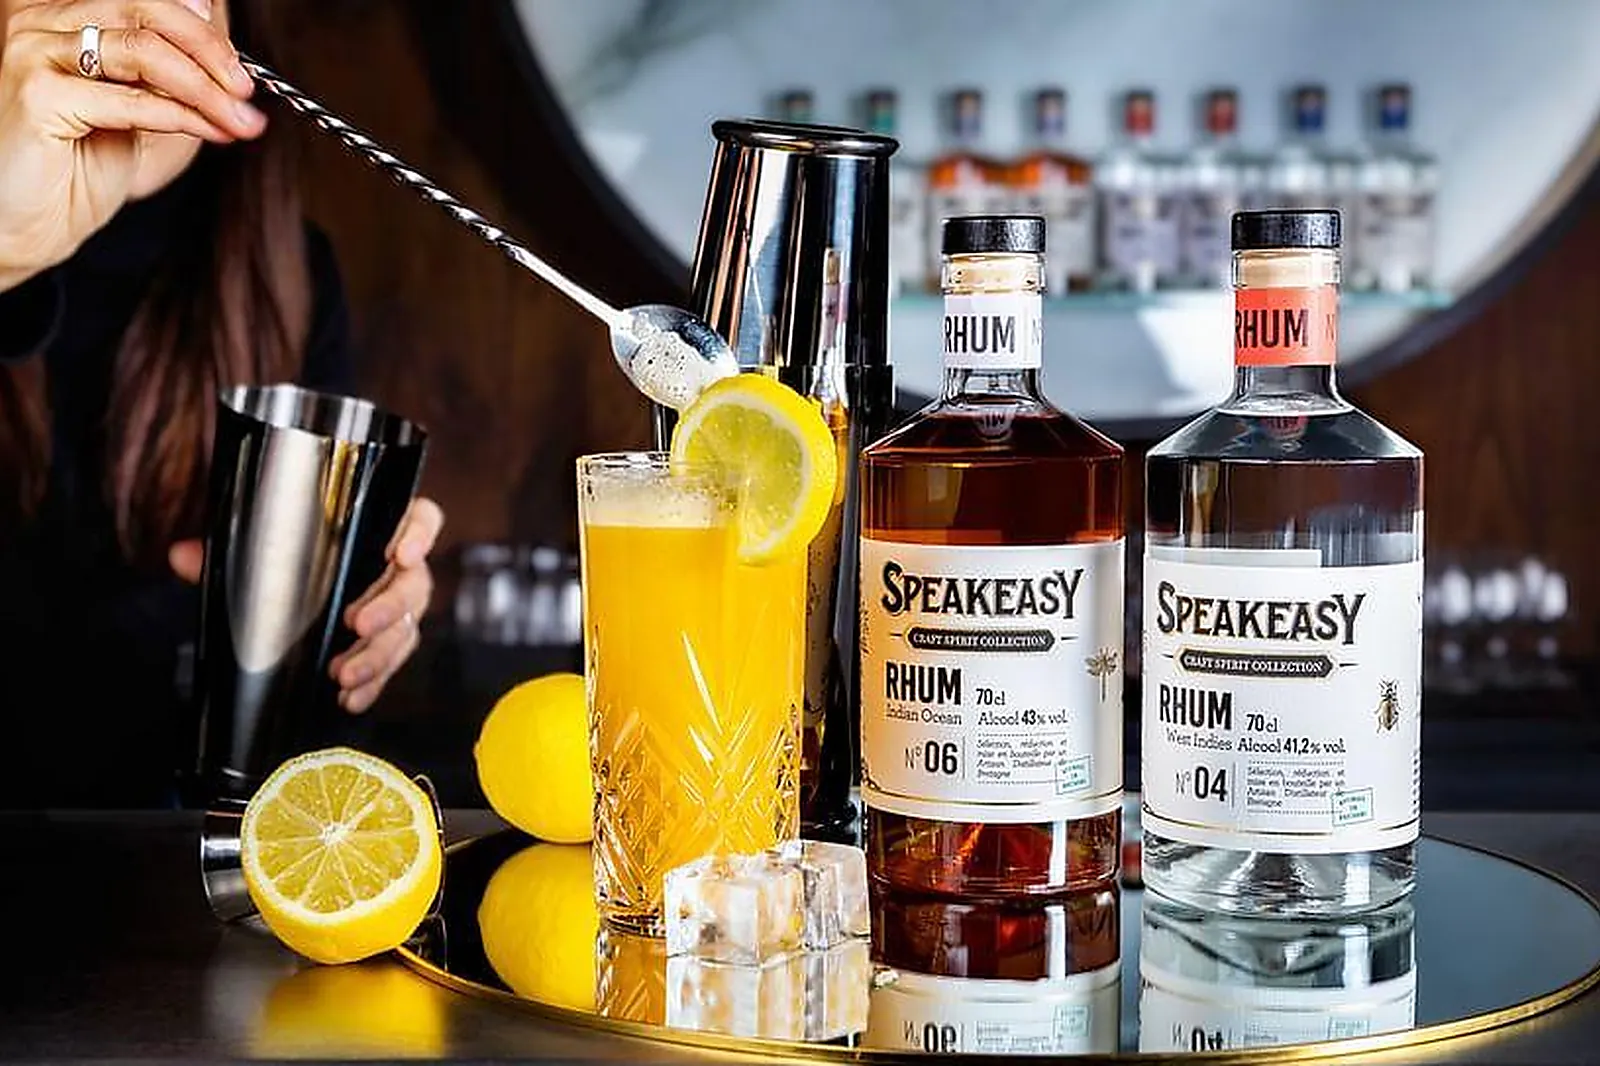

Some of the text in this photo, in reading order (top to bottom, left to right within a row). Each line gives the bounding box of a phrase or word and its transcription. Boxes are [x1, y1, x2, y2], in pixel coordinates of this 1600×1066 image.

[944, 315, 1016, 354] RHUM
[1234, 309, 1309, 348] RHUM
[882, 561, 1084, 619] SPEAKEASY
[1157, 581, 1366, 645] SPEAKEASY
[979, 635, 1047, 647] COLLECTION
[1214, 659, 1249, 671] SPIRIT
[1251, 661, 1324, 673] COLLECTION
[886, 661, 962, 705] RHUM
[886, 703, 962, 725] Indian Ocean
[978, 710, 1019, 725] Alcool
[1159, 684, 1232, 730] RHUM
[1193, 732, 1233, 751] Indies
[1237, 737, 1281, 753] Alcool
